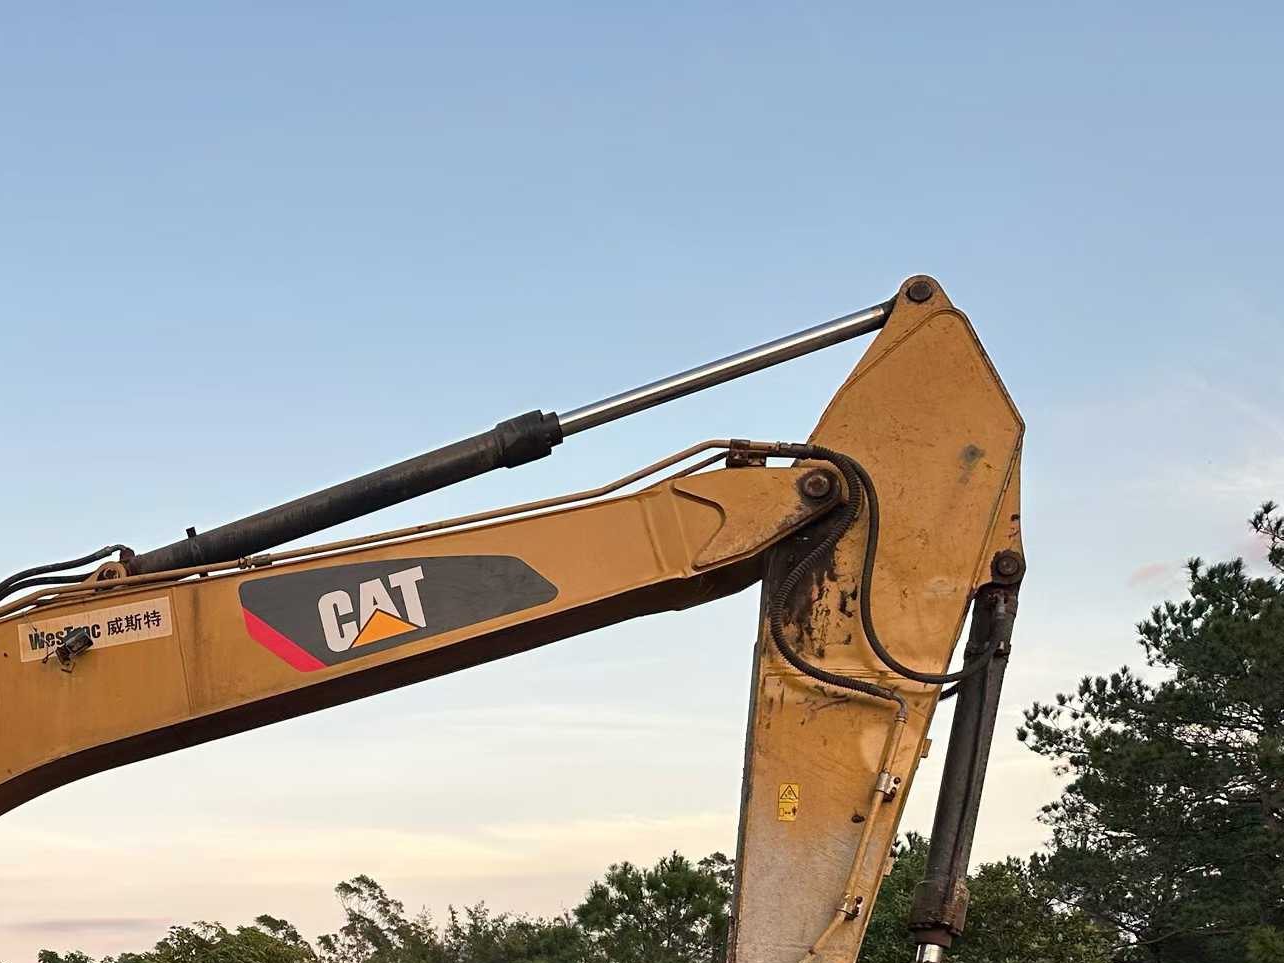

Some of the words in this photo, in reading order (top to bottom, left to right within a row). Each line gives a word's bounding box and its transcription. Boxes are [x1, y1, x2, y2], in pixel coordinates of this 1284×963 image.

[28, 623, 101, 650] WesTc
[107, 609, 162, 636] 威斯特
[318, 566, 427, 652] CAT
